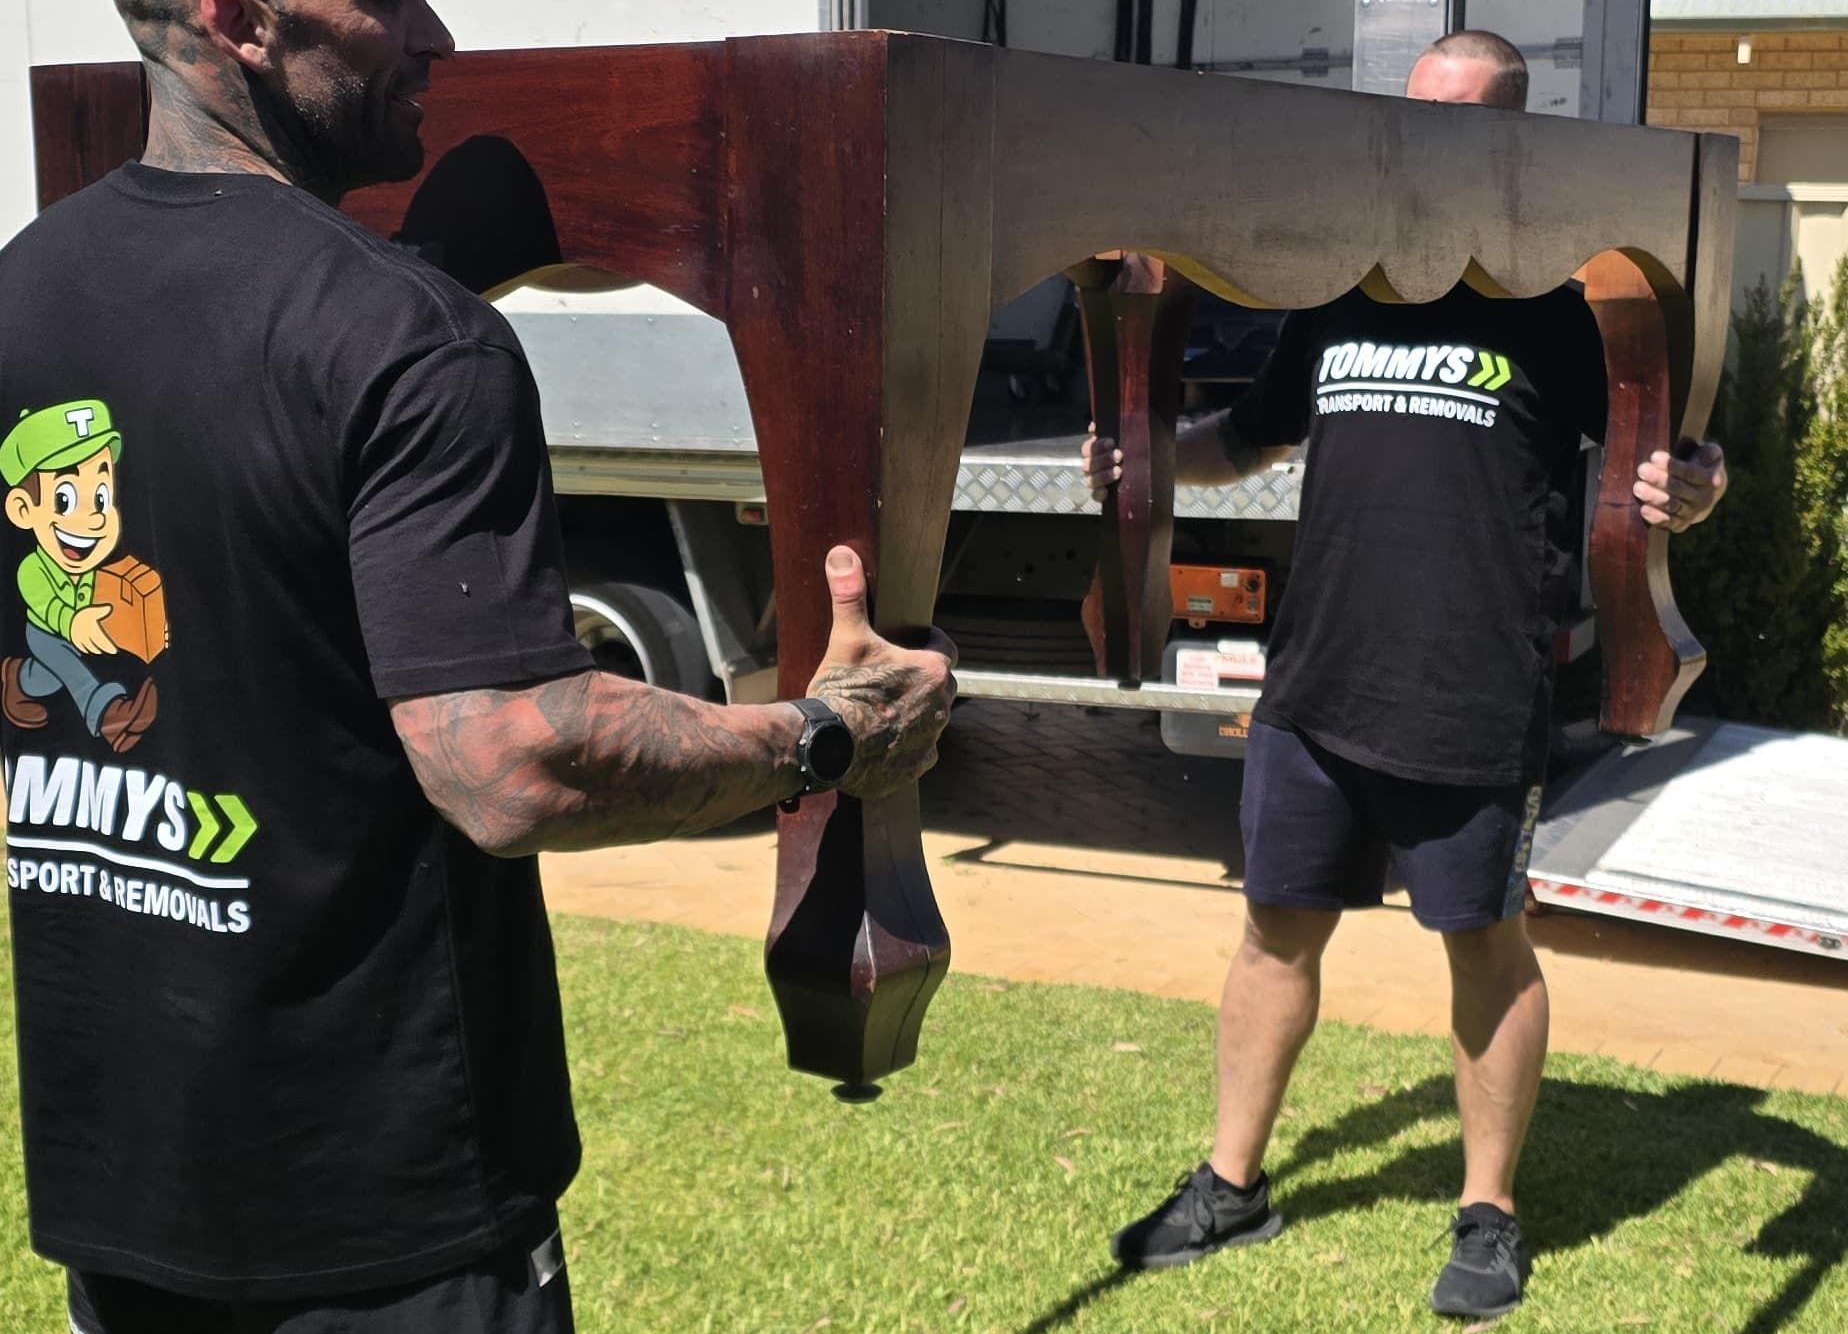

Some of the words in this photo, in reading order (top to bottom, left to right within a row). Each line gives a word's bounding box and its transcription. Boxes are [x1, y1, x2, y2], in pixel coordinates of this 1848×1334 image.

[1318, 341, 1475, 384] TOMMYS
[65, 407, 94, 438] T
[1394, 395, 1407, 414] &
[1408, 396, 1497, 428] REMOVALS
[5, 755, 187, 851] MMYS
[99, 870, 113, 903] &
[113, 877, 251, 934] REMOVALS
